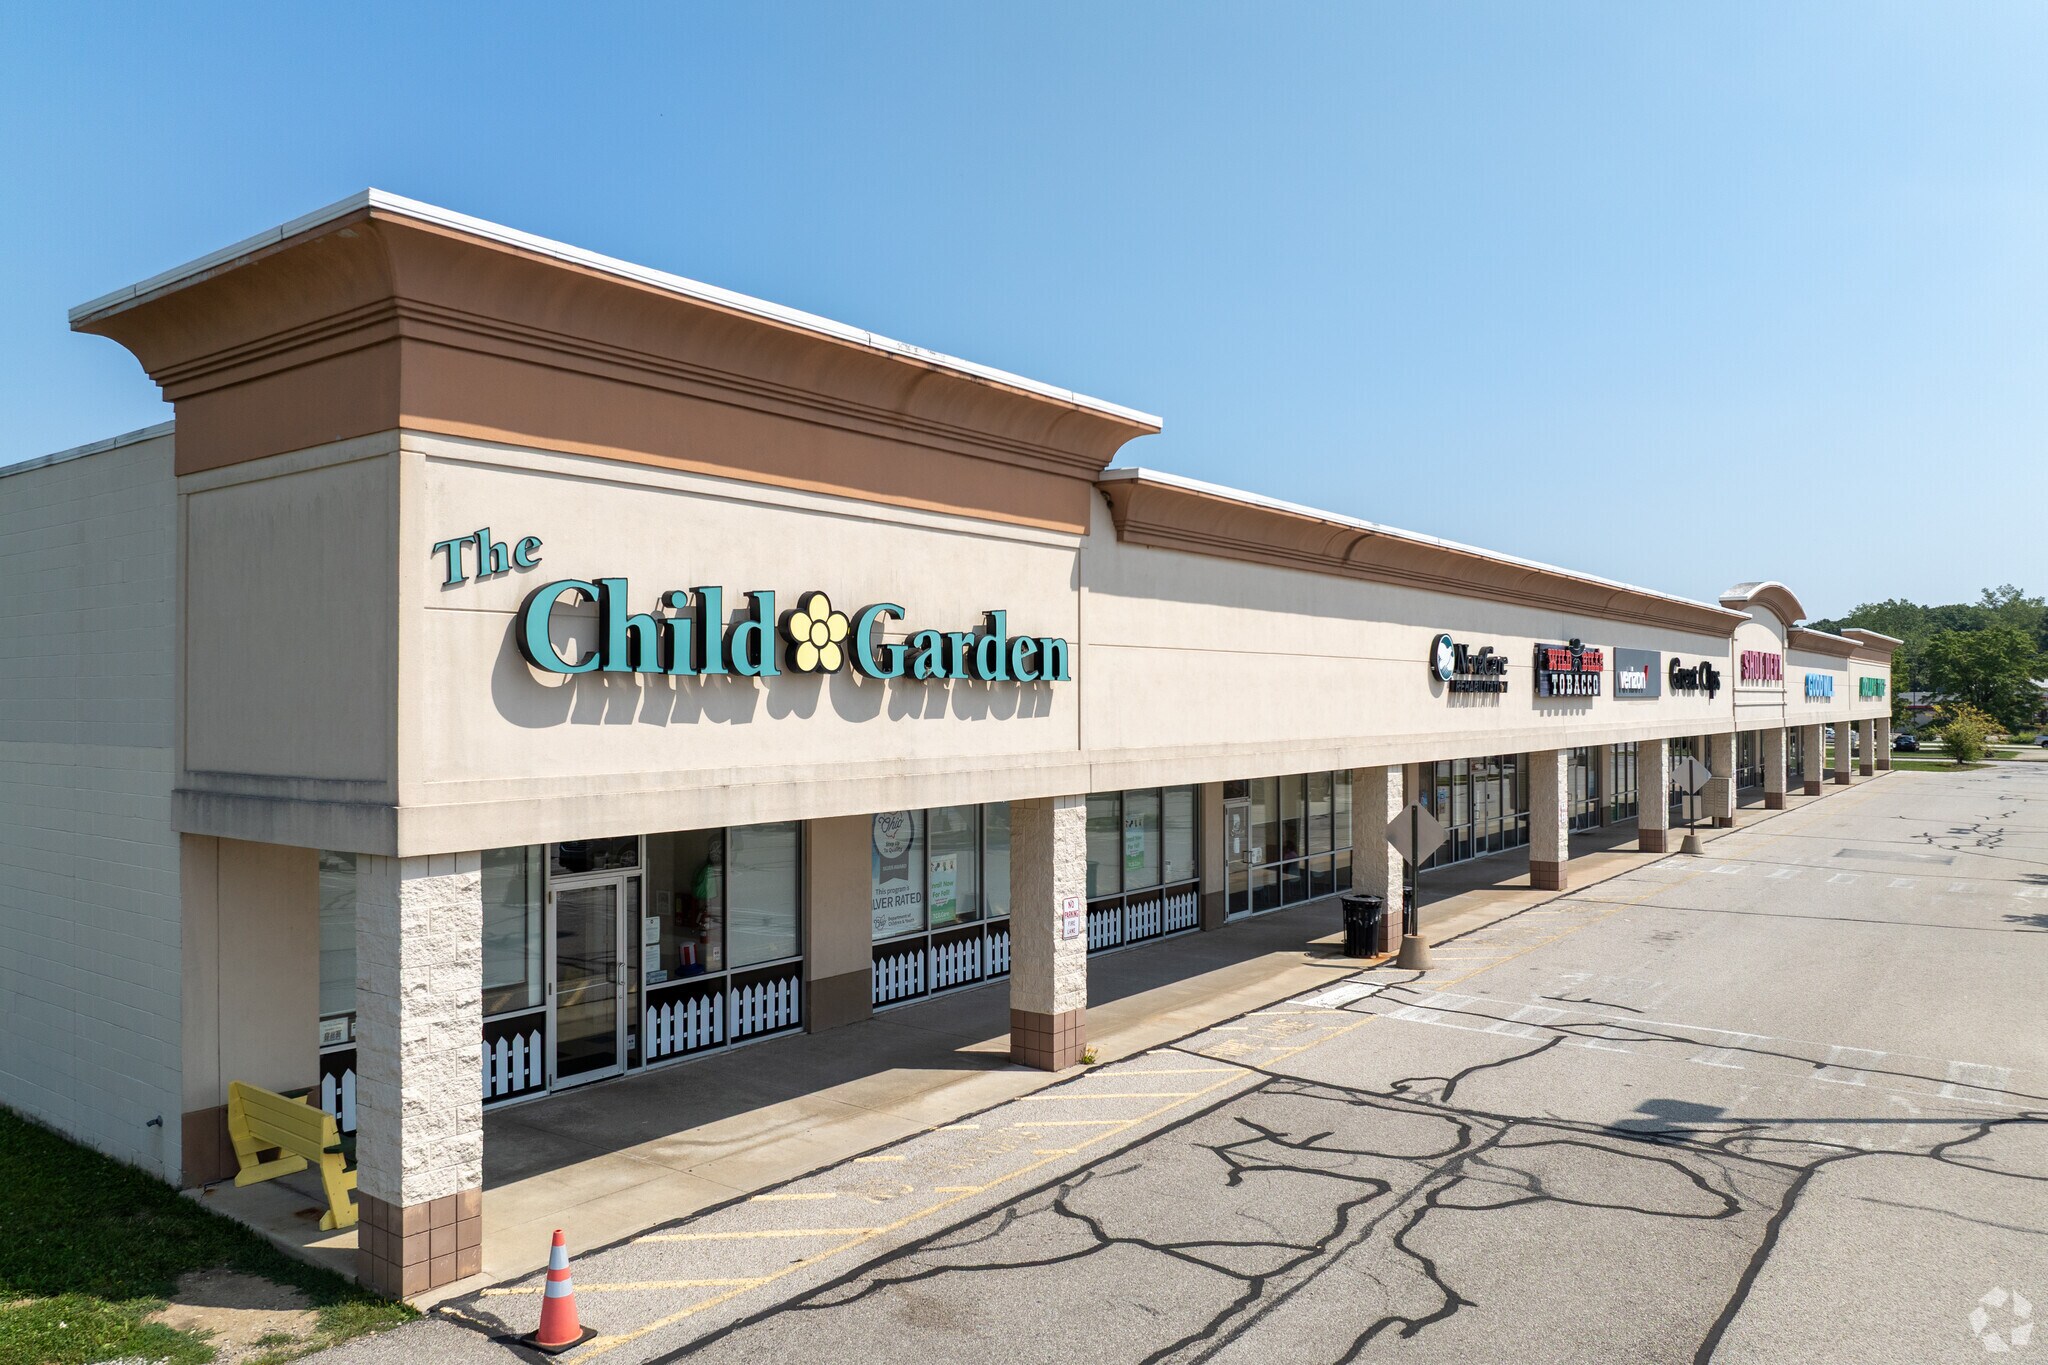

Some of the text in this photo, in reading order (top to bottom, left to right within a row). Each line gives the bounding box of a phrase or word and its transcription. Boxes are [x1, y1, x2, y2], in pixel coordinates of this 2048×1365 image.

[432, 526, 543, 586] The
[515, 576, 1072, 682] Child Garden
[1547, 648, 1573, 671] WILD
[1551, 673, 1599, 695] TOBACCO
[1618, 666, 1647, 689] verizon
[878, 815, 904, 833] Ohio
[872, 896, 894, 910] LVER
[895, 892, 922, 907] RATED
